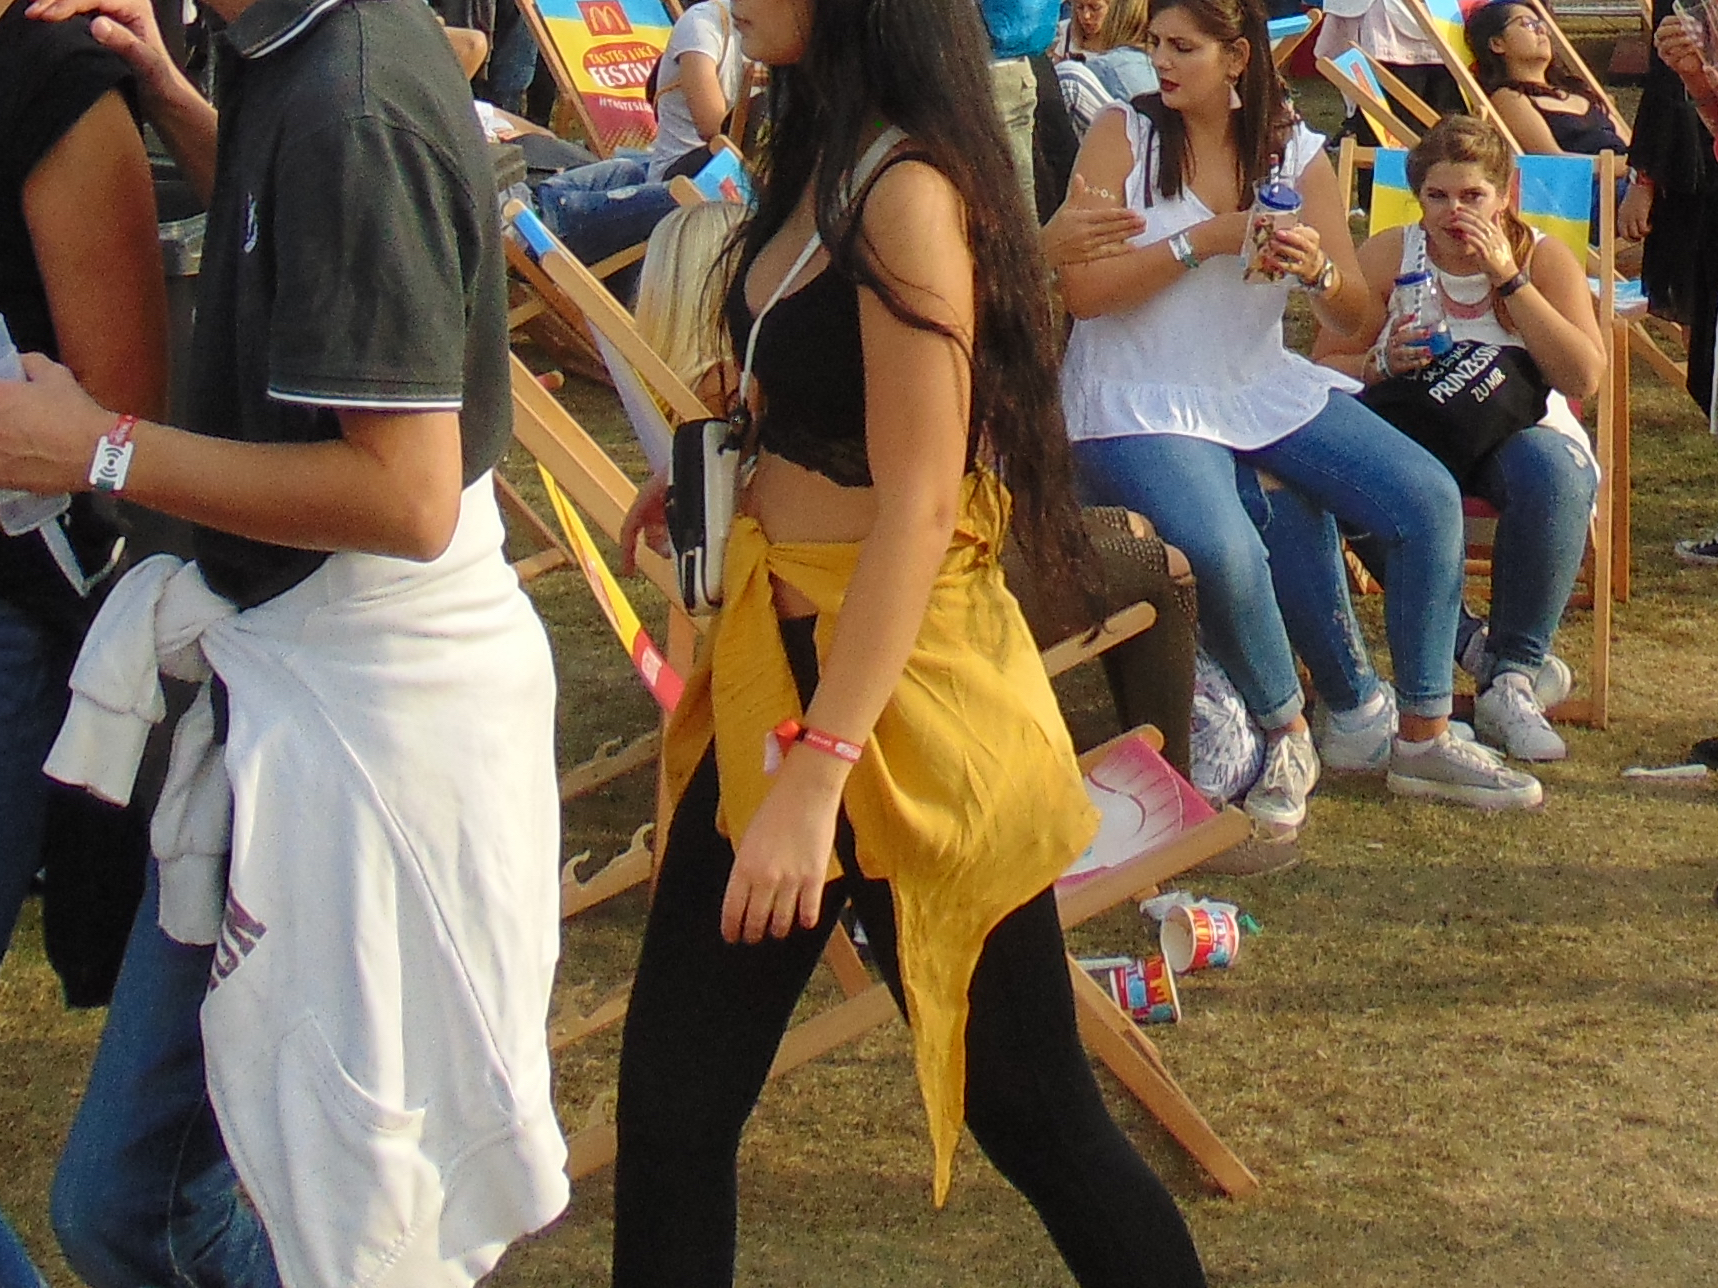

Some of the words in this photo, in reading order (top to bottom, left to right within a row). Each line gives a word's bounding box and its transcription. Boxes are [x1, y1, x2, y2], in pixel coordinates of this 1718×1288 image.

[586, 49, 628, 65] TASTES
[1470, 382, 1490, 403] ZU
[1485, 366, 1506, 391] MIR
